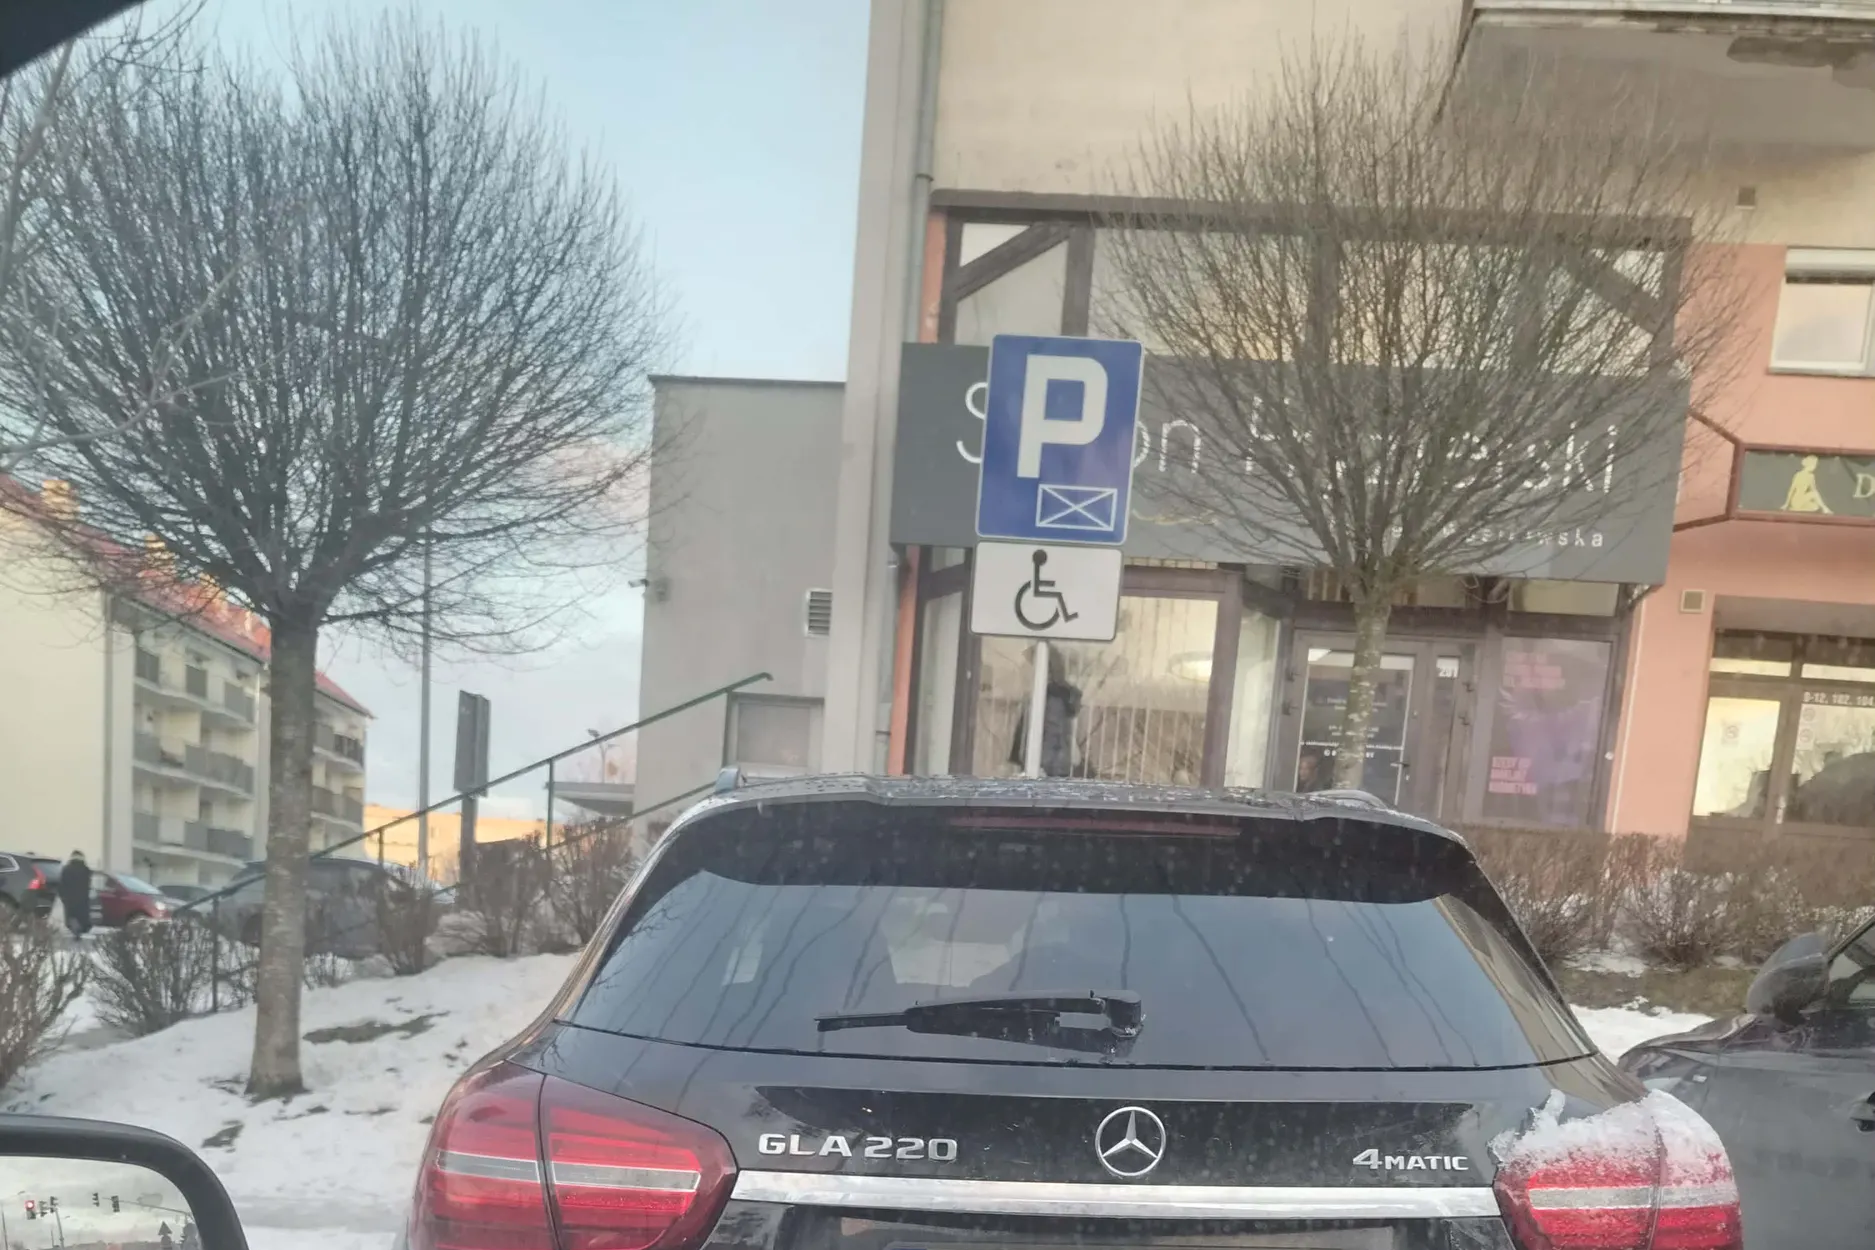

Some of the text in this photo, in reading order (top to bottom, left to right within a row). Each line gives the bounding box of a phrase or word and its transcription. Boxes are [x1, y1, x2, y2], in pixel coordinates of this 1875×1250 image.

[1017, 354, 1108, 478] P
[758, 1133, 958, 1161] GLA 220
[1352, 1148, 1469, 1171] 4MATIC
